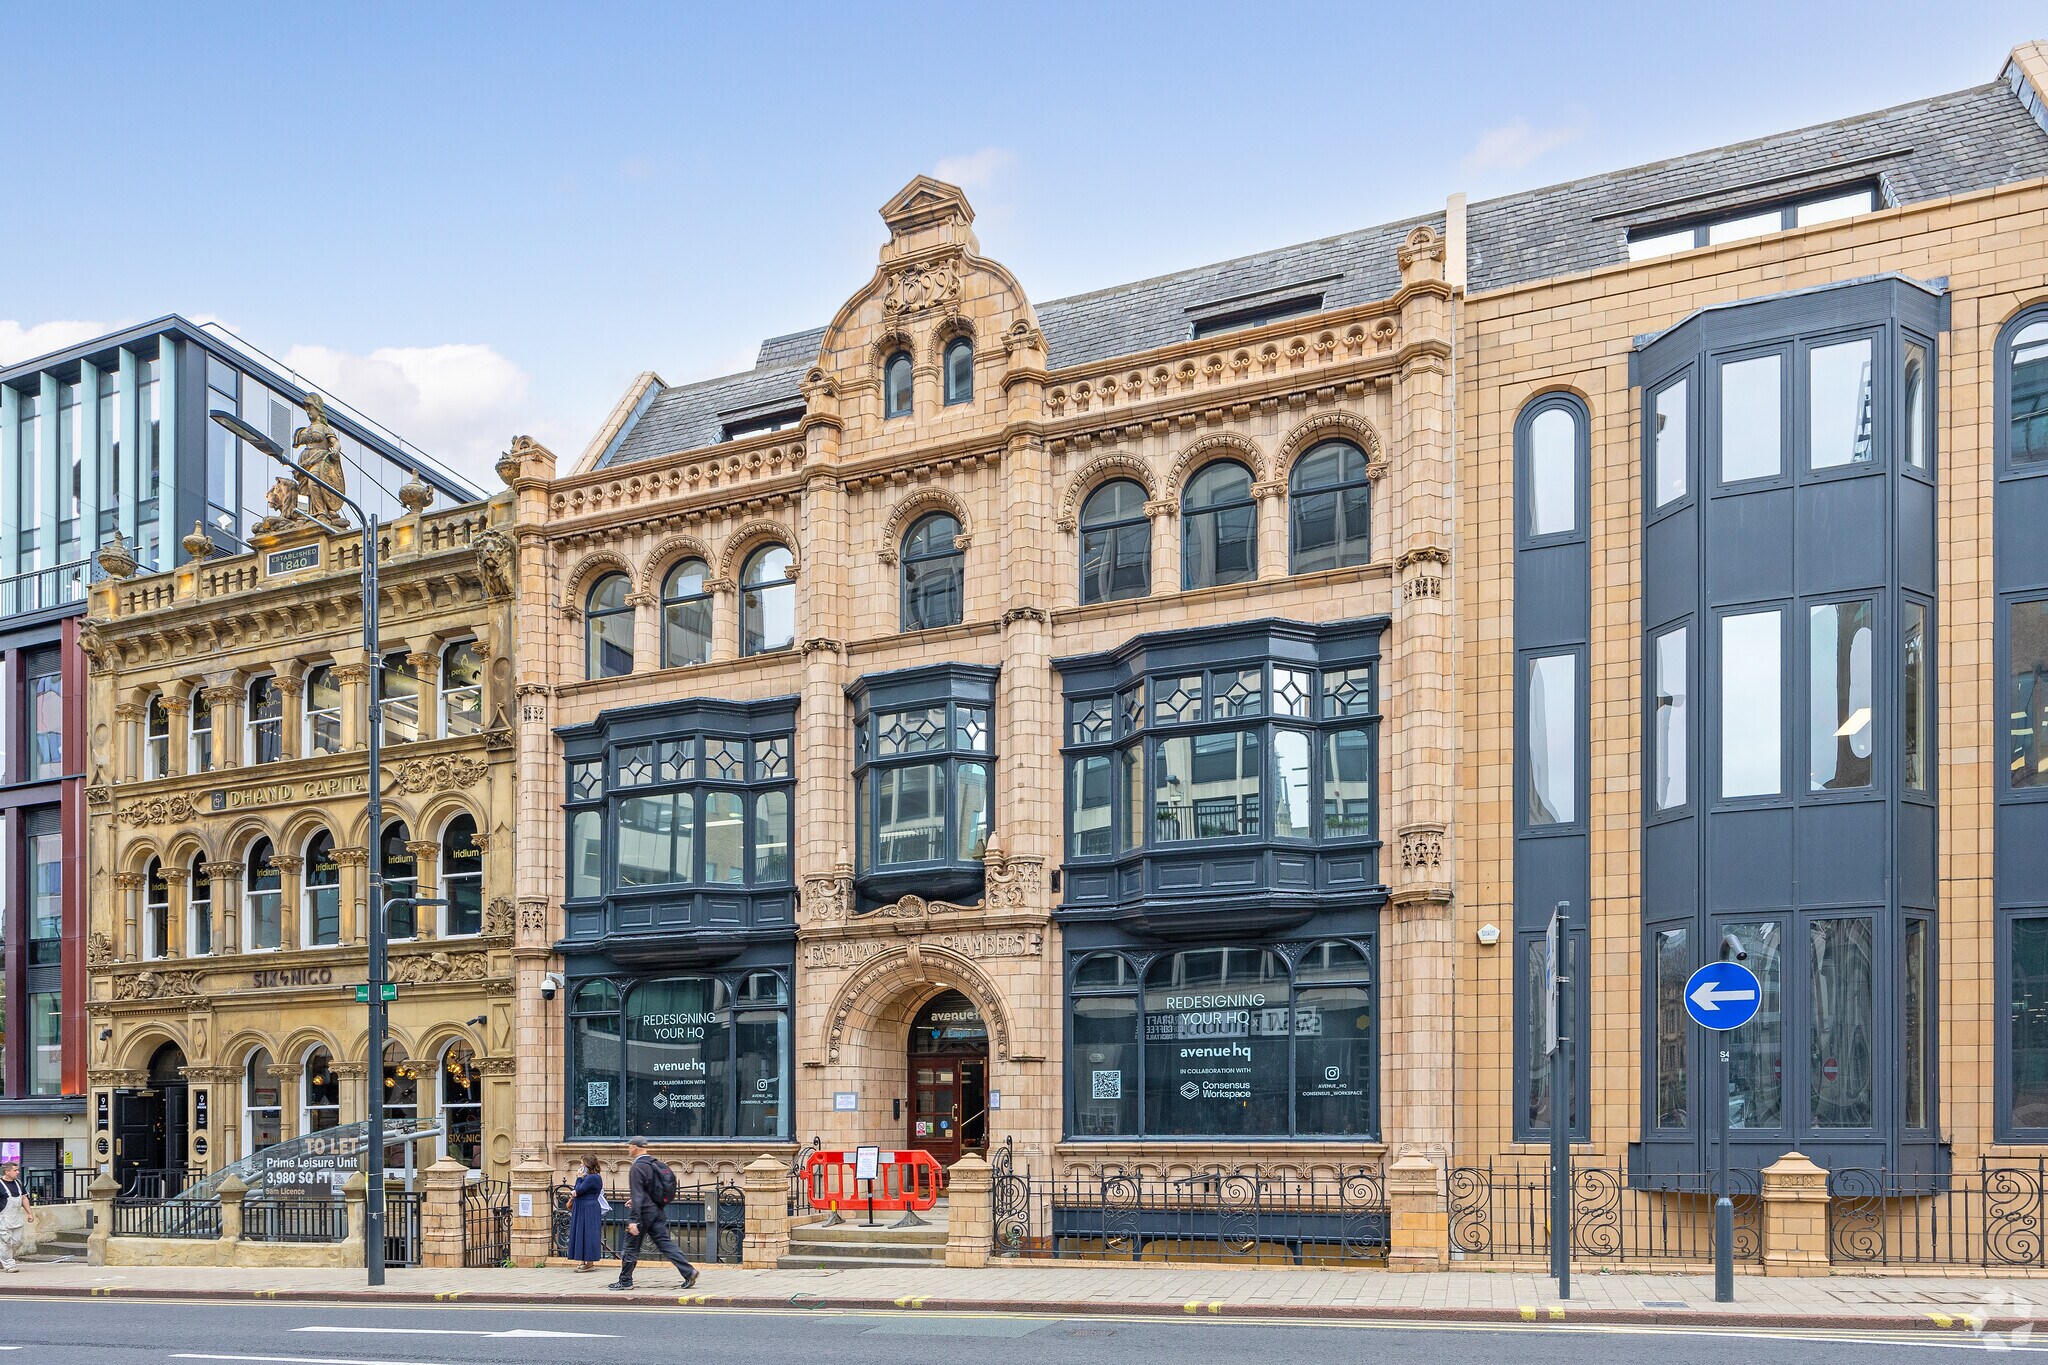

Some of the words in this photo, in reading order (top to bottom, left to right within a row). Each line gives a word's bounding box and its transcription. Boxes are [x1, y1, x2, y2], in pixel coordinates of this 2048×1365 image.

[271, 549, 317, 563] ESTABLISHED
[280, 558, 308, 572] 1840
[230, 784, 294, 807] DHAND
[304, 775, 369, 798] CAPITA
[388, 854, 414, 864] Iridium
[453, 848, 480, 859] Iridium
[256, 868, 280, 878] Iridium
[808, 944, 840, 968] EAST
[941, 933, 1026, 959] CHAMBERS
[253, 970, 277, 988] SIX
[291, 967, 332, 985] NICO
[1166, 993, 1266, 1010] REDESIGNING
[643, 1012, 716, 1026] REDESIGNING
[1181, 1012, 1222, 1026] YOUR
[1226, 1010, 1250, 1027] HQ
[654, 1027, 685, 1040] YOUR
[687, 1026, 705, 1040] HQ
[1202, 1081, 1251, 1090] Consensus
[199, 1094, 205, 1103] 9
[669, 1093, 705, 1101] Consensus
[1202, 1090, 1251, 1100] Workspace
[100, 1097, 106, 1105] 9
[669, 1101, 706, 1109] Workspace
[448, 1133, 462, 1143] SIX
[466, 1133, 481, 1143] NIC
[305, 1138, 326, 1155] TO
[330, 1137, 358, 1154] LET
[266, 1157, 295, 1168] Prime
[297, 1157, 335, 1168] Leisure
[336, 1157, 358, 1168] Unit
[267, 1171, 296, 1186] 3,980
[298, 1171, 314, 1184] SQ
[316, 1171, 330, 1184] FT
[265, 1187, 279, 1196] 5am
[280, 1187, 306, 1196] Licence
